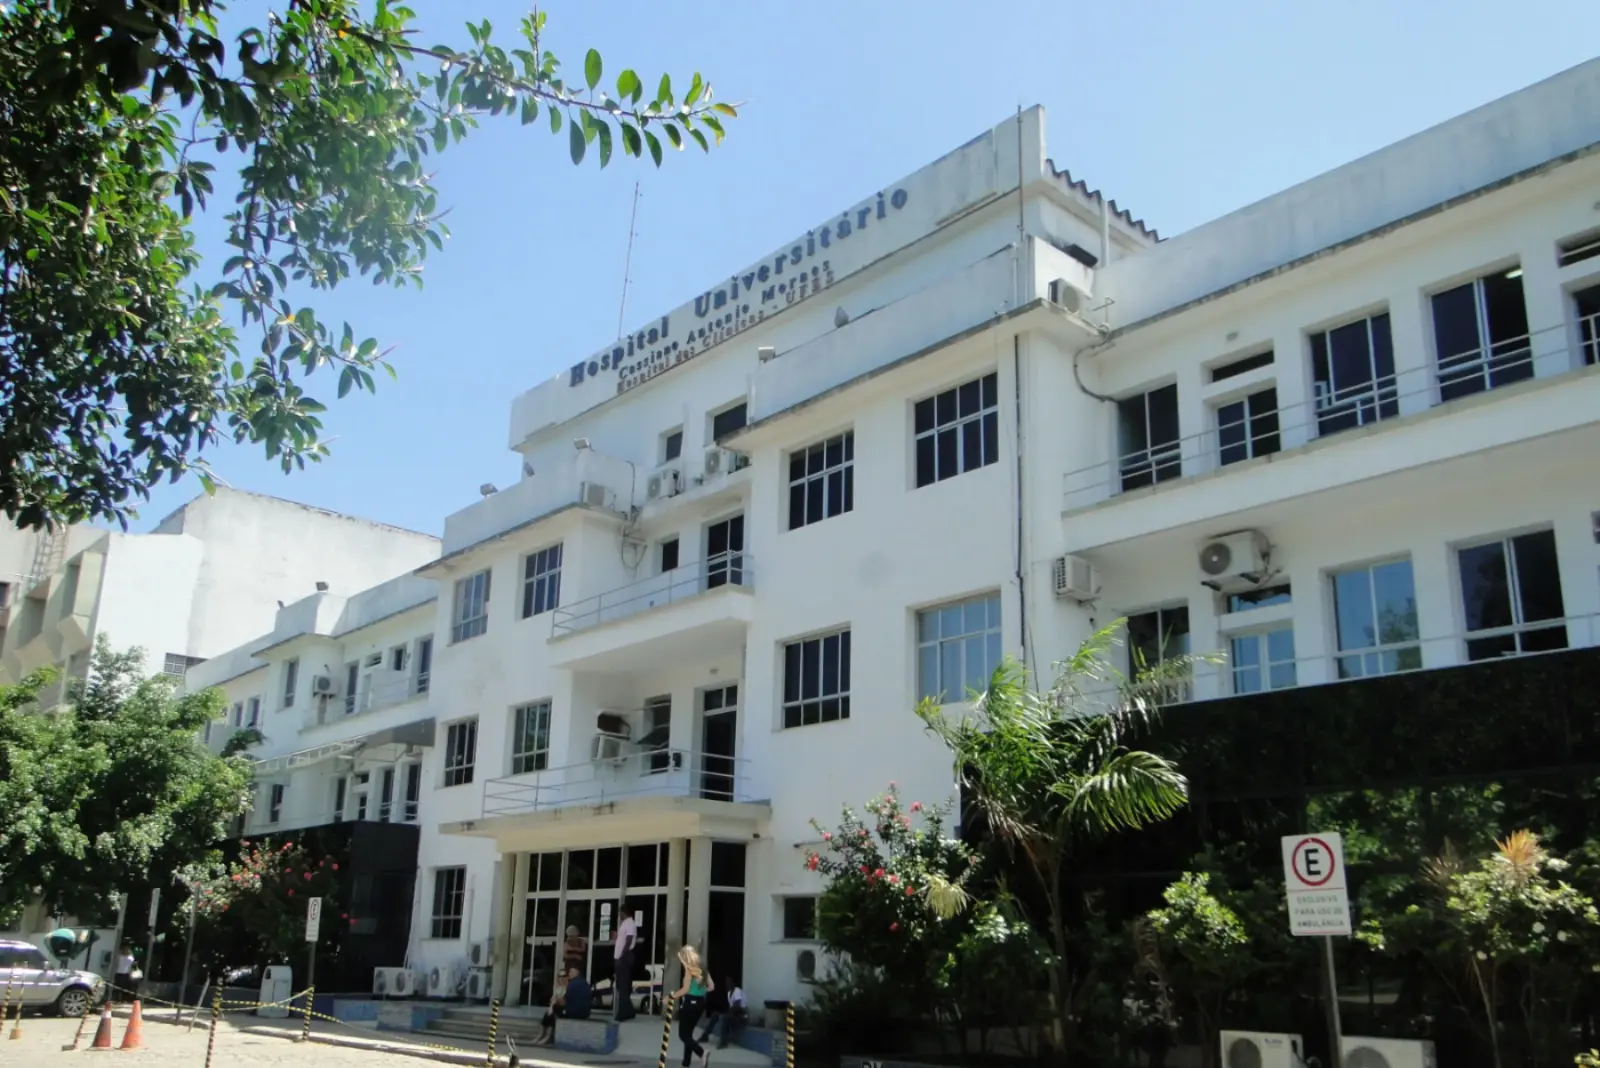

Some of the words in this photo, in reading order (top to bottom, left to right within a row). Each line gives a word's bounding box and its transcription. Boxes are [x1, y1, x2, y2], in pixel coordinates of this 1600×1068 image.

[569, 316, 669, 387] Hospital
[694, 189, 908, 318] Universitário
[619, 341, 679, 379] Cassiano
[761, 260, 830, 304] Moraes
[1304, 848, 1321, 876] E
